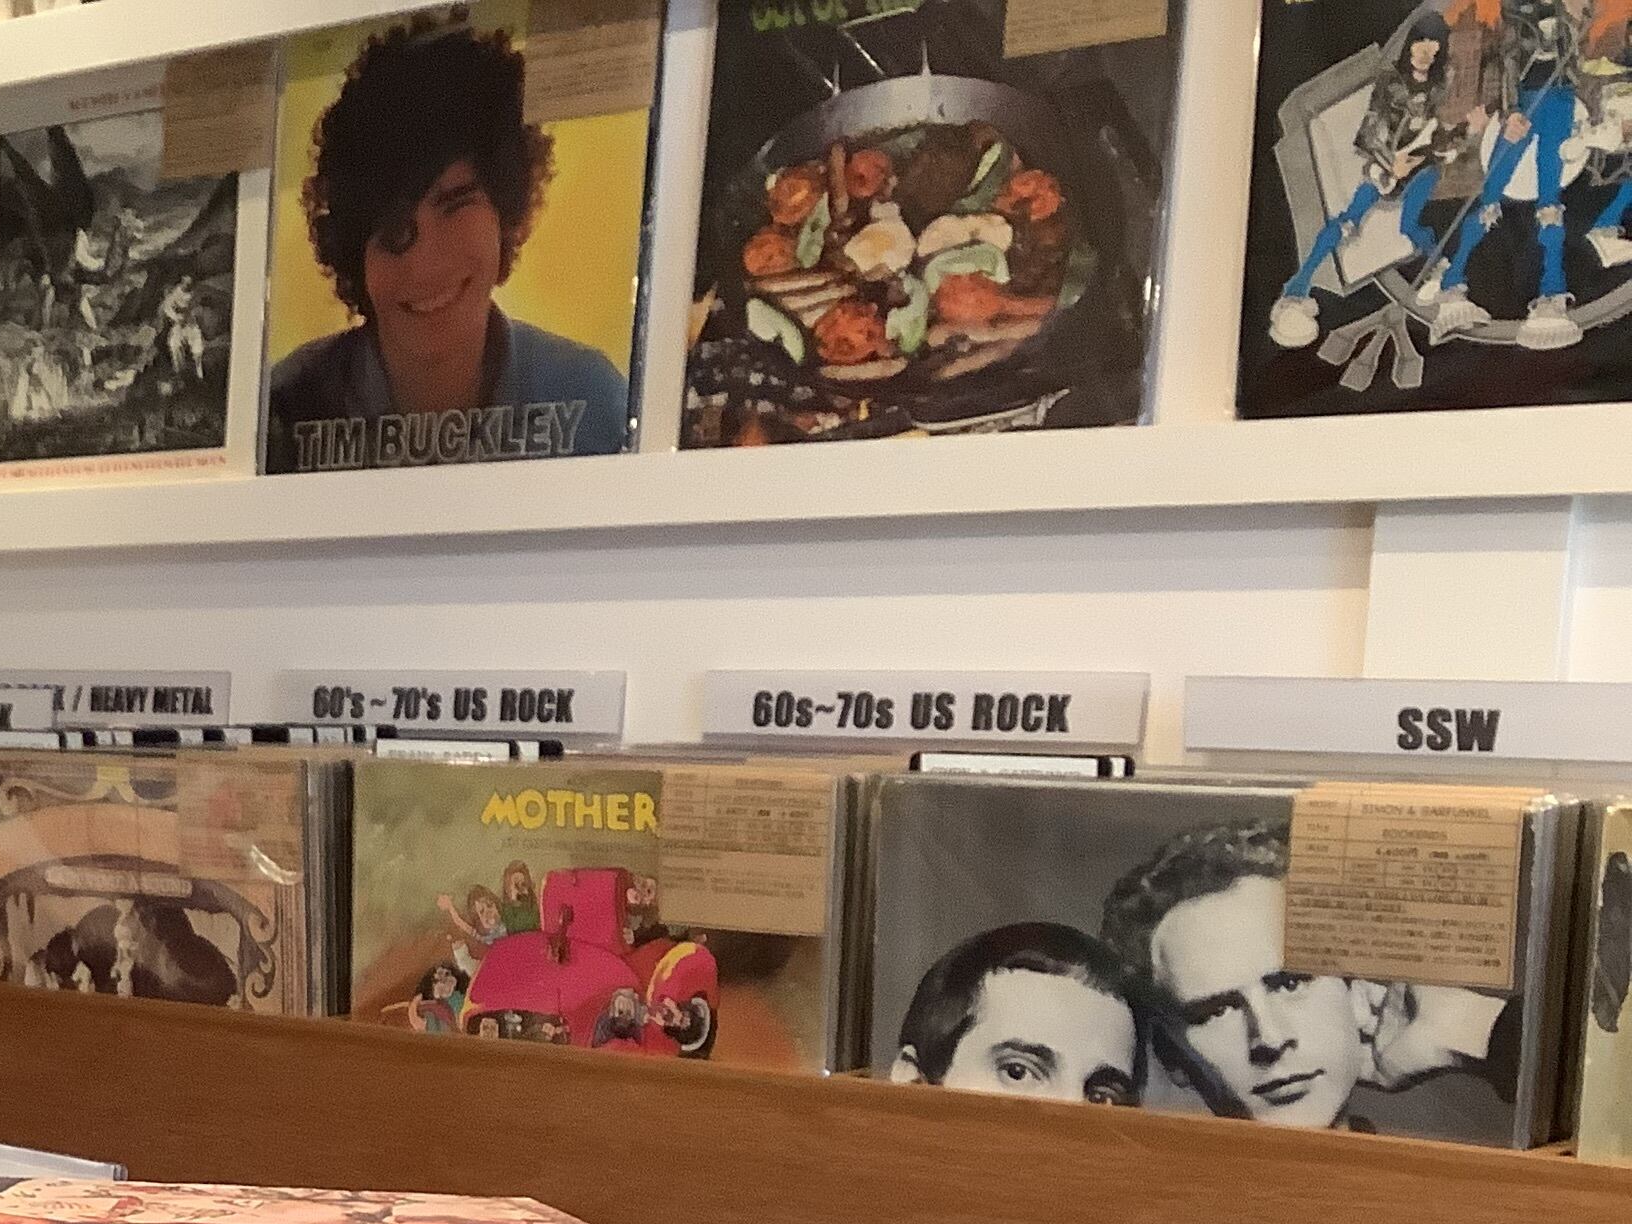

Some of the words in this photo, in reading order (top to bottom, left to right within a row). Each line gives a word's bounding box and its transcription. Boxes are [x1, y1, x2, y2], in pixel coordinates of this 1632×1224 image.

[294, 417, 366, 470] TIM
[376, 400, 586, 465] BUCKLEY
[89, 686, 148, 713] HEAVY
[152, 686, 214, 714] METAL
[453, 687, 489, 722] US
[499, 688, 576, 723] ROCK
[909, 692, 956, 731] US
[971, 693, 1072, 733] ROCK
[1396, 707, 1501, 752] SSW
[480, 789, 660, 838] MOTHER
